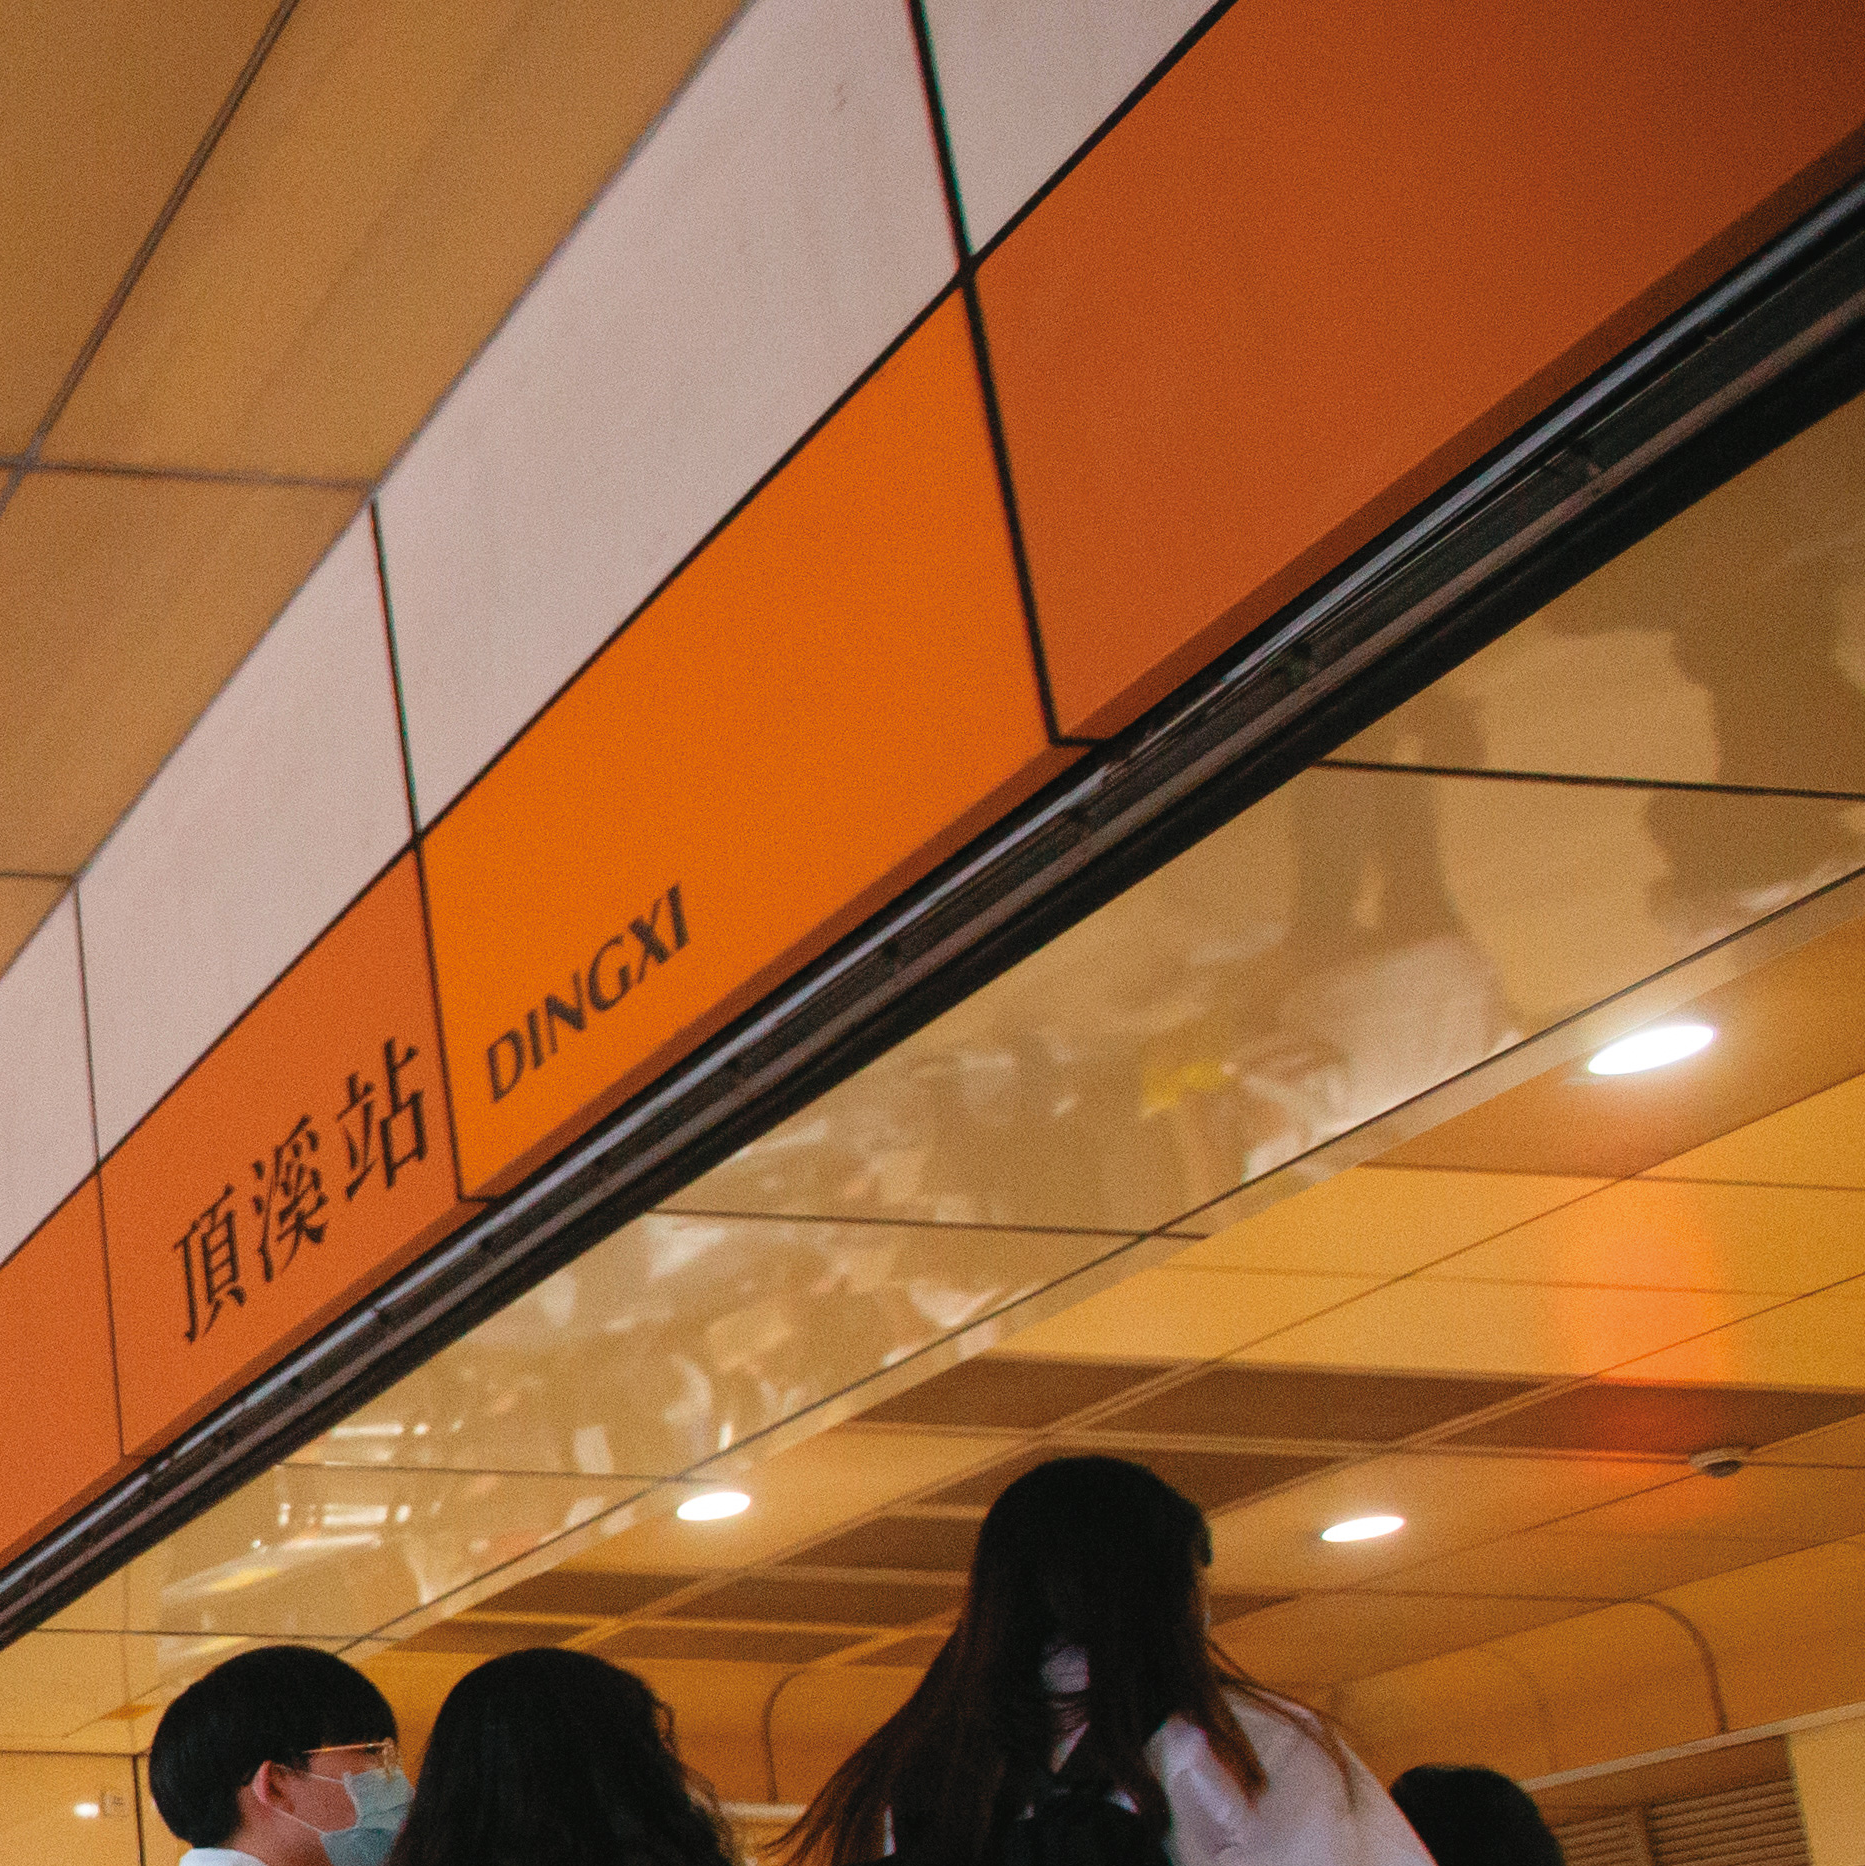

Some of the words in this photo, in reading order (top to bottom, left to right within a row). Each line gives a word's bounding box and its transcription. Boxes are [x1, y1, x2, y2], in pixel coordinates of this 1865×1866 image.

[483, 882, 693, 1104] DINGXI
[172, 1036, 433, 1344] 頂溪站
